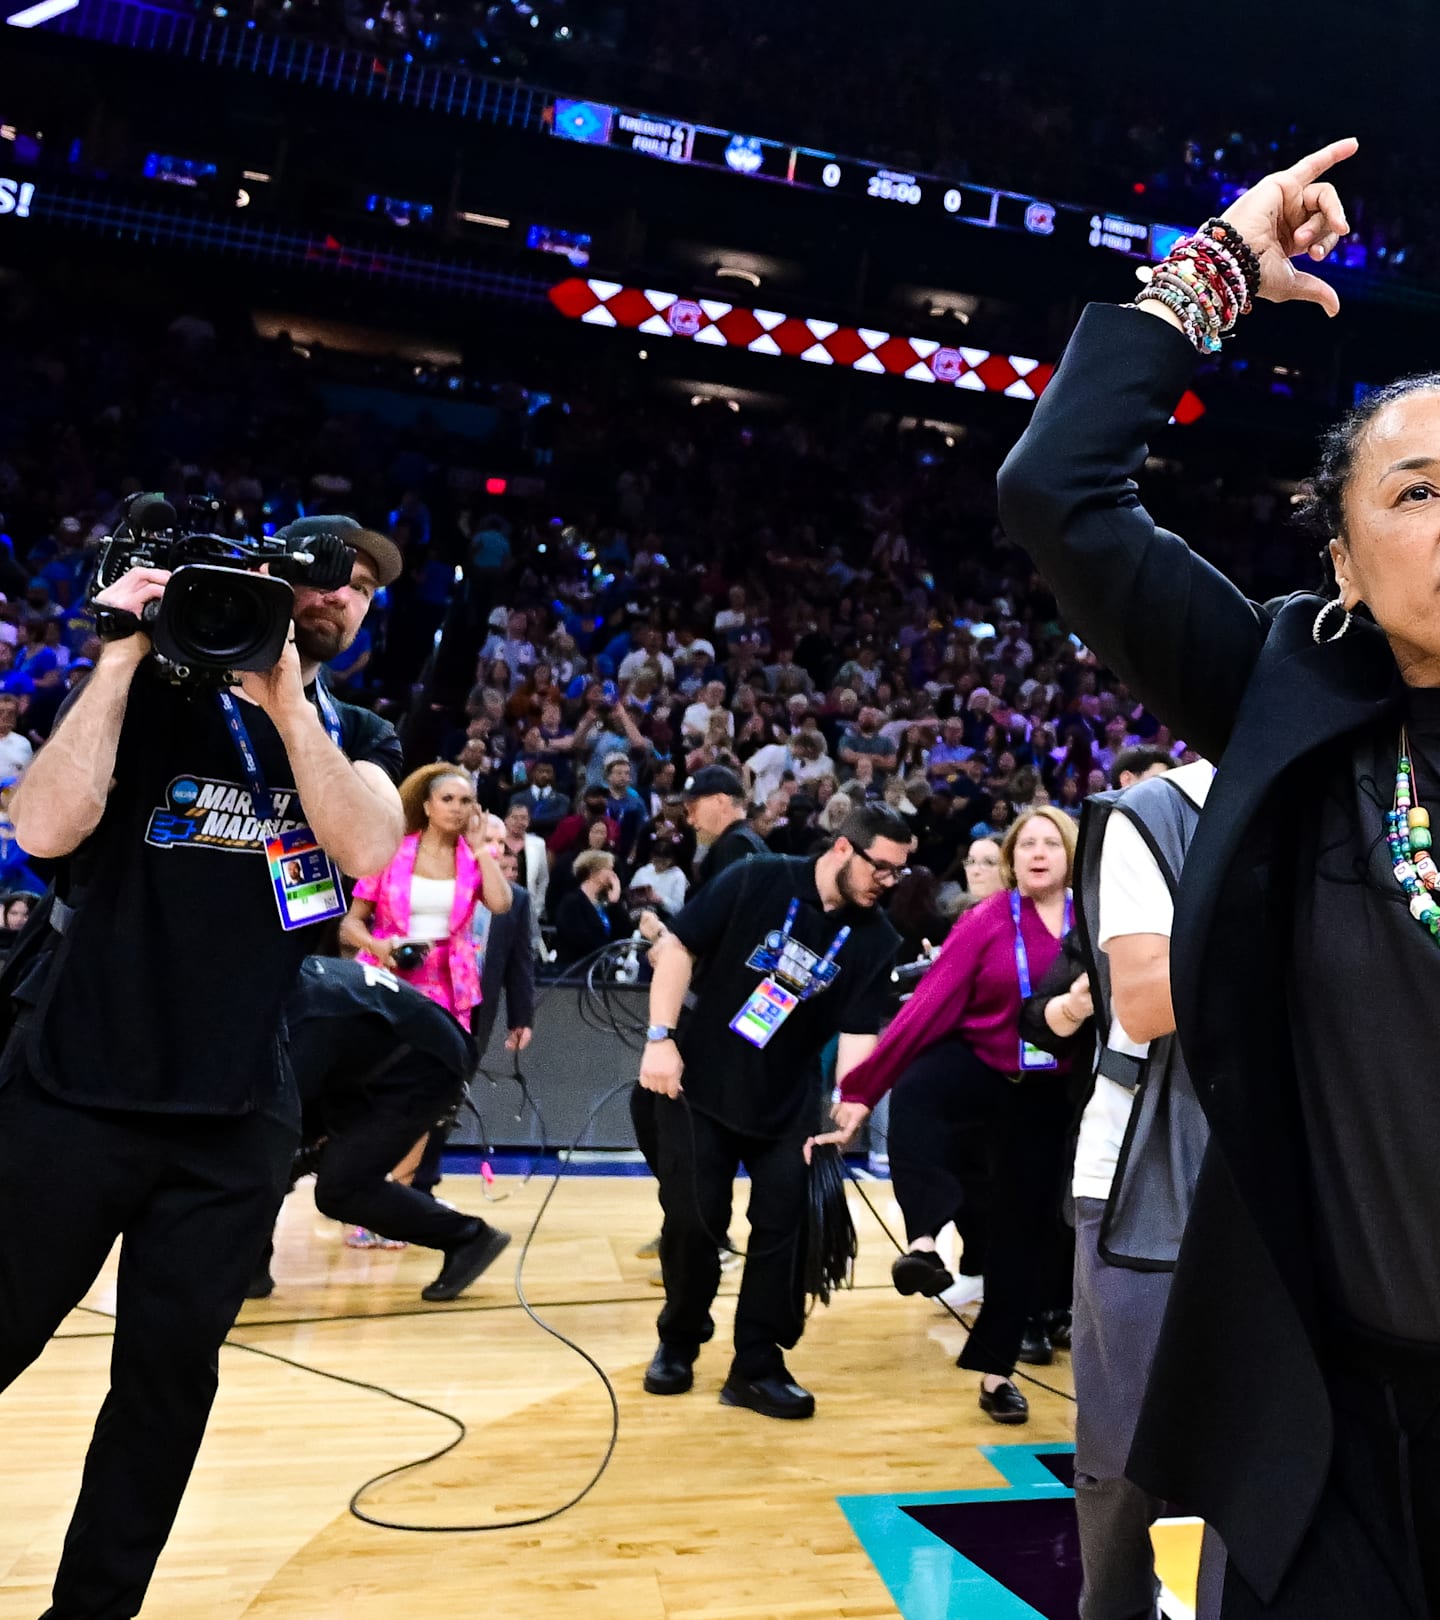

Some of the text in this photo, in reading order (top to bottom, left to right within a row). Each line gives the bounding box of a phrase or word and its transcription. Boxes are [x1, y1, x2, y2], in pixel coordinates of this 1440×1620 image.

[823, 163, 841, 187] 0
[867, 176, 921, 205] 25:00
[943, 189, 961, 212] 0
[196, 783, 291, 818] MARH
